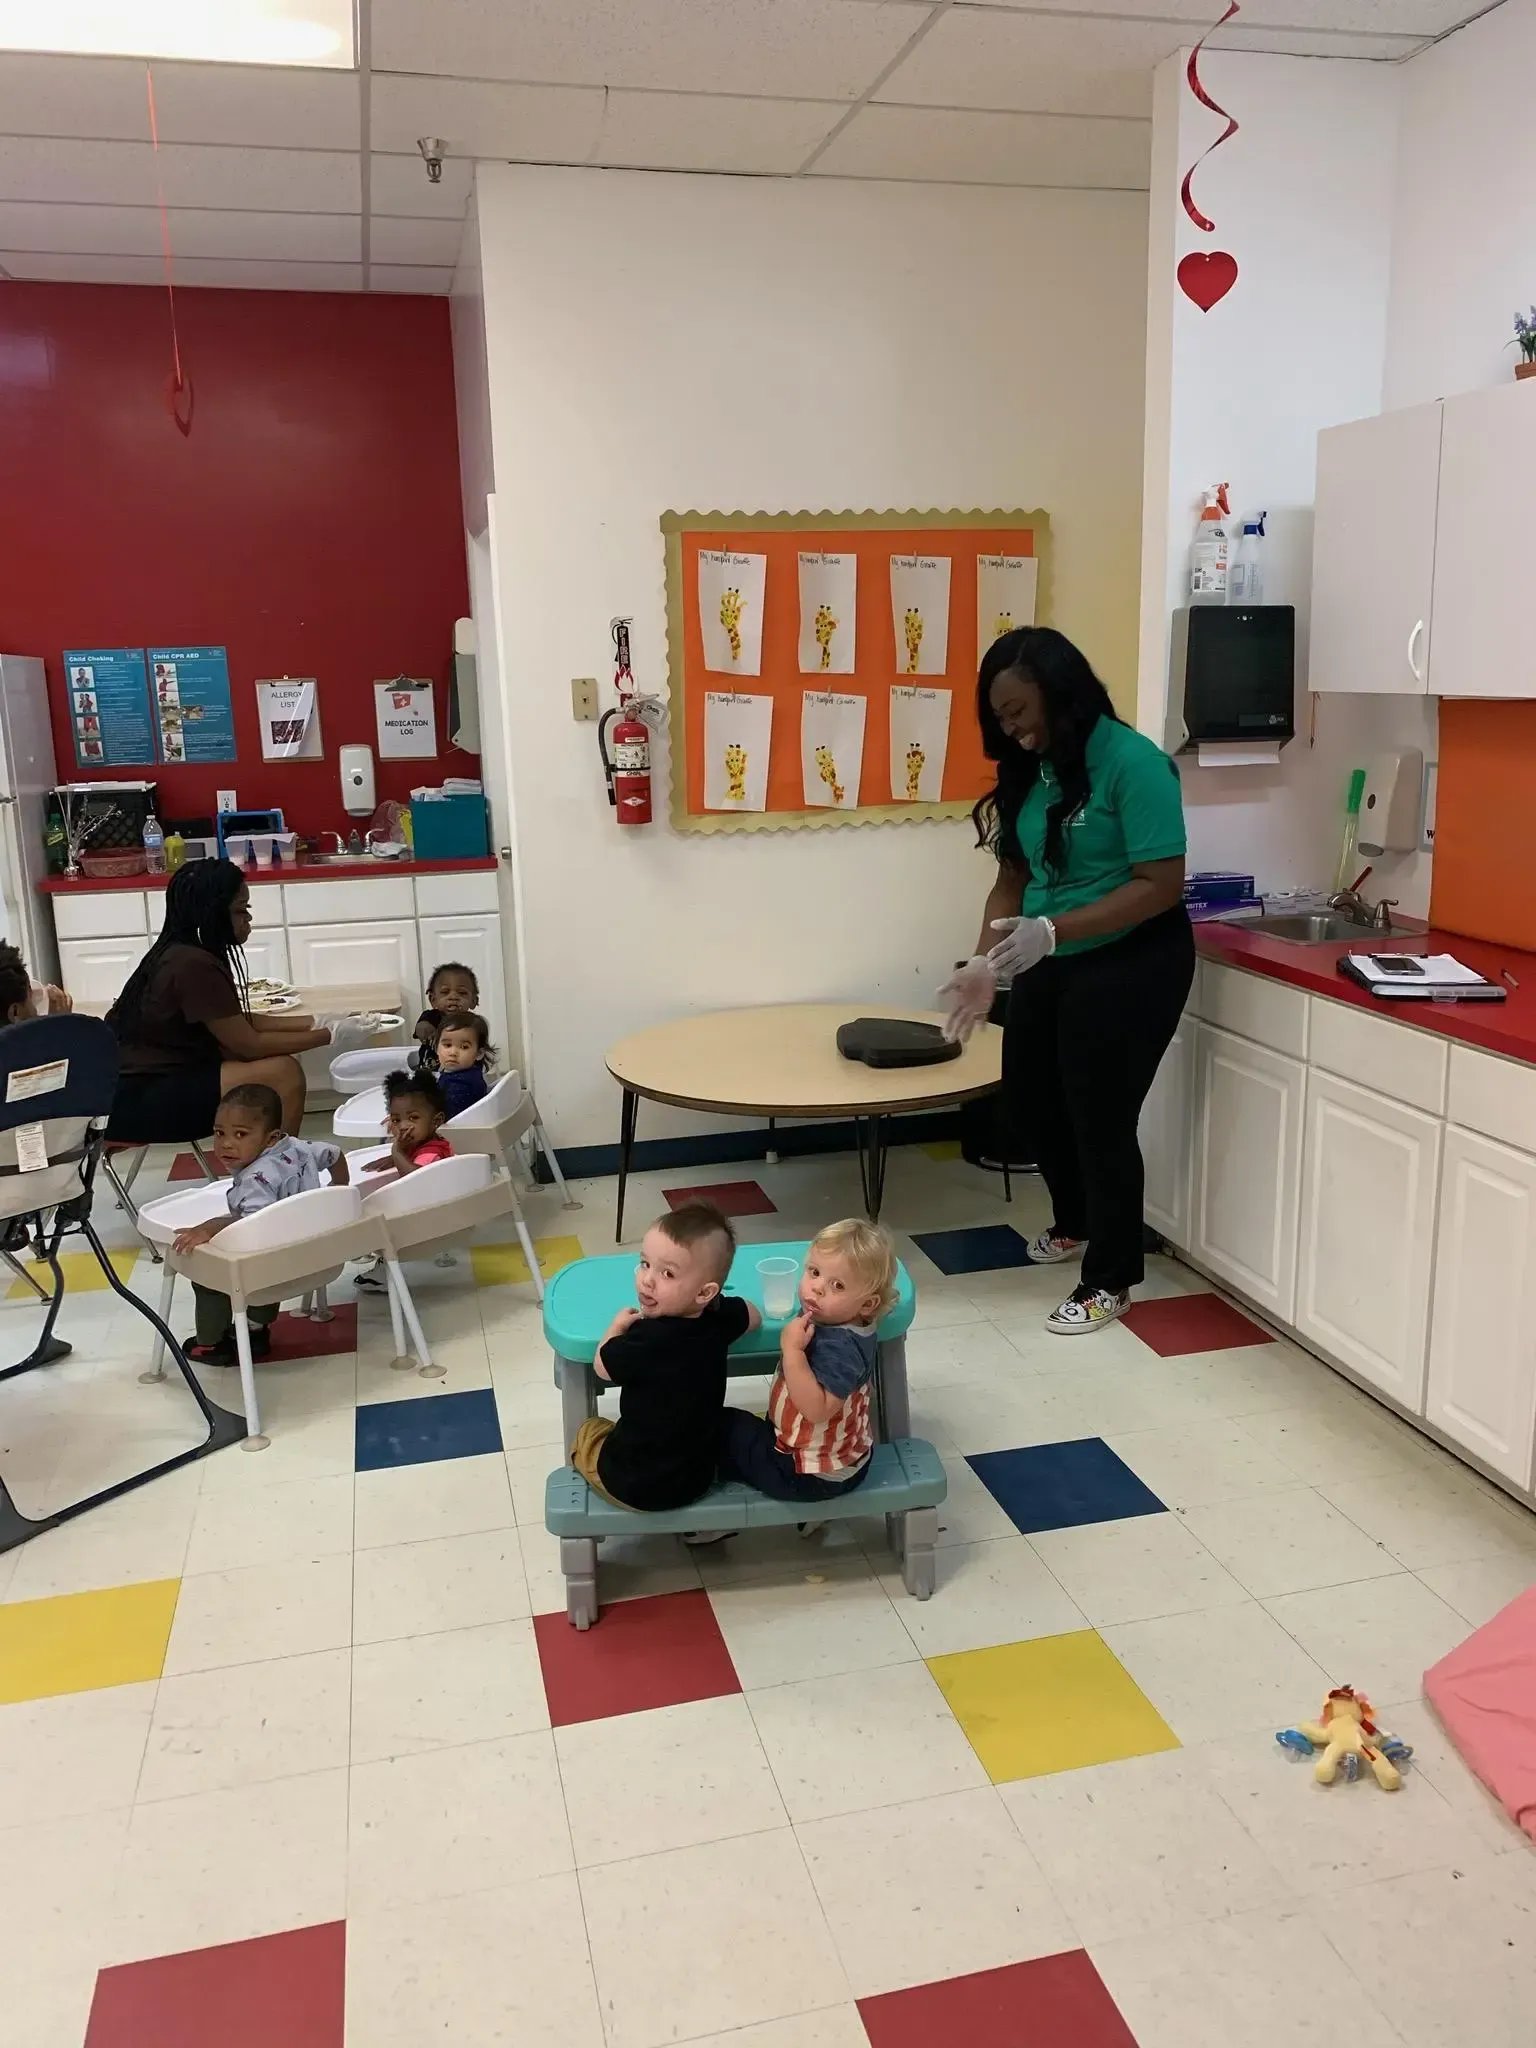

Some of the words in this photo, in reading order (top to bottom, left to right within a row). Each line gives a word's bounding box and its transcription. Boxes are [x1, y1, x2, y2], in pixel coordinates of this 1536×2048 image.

[619, 628, 629, 664] FIRE
[271, 691, 302, 699] ALLERGY
[400, 728, 414, 736] LOG
